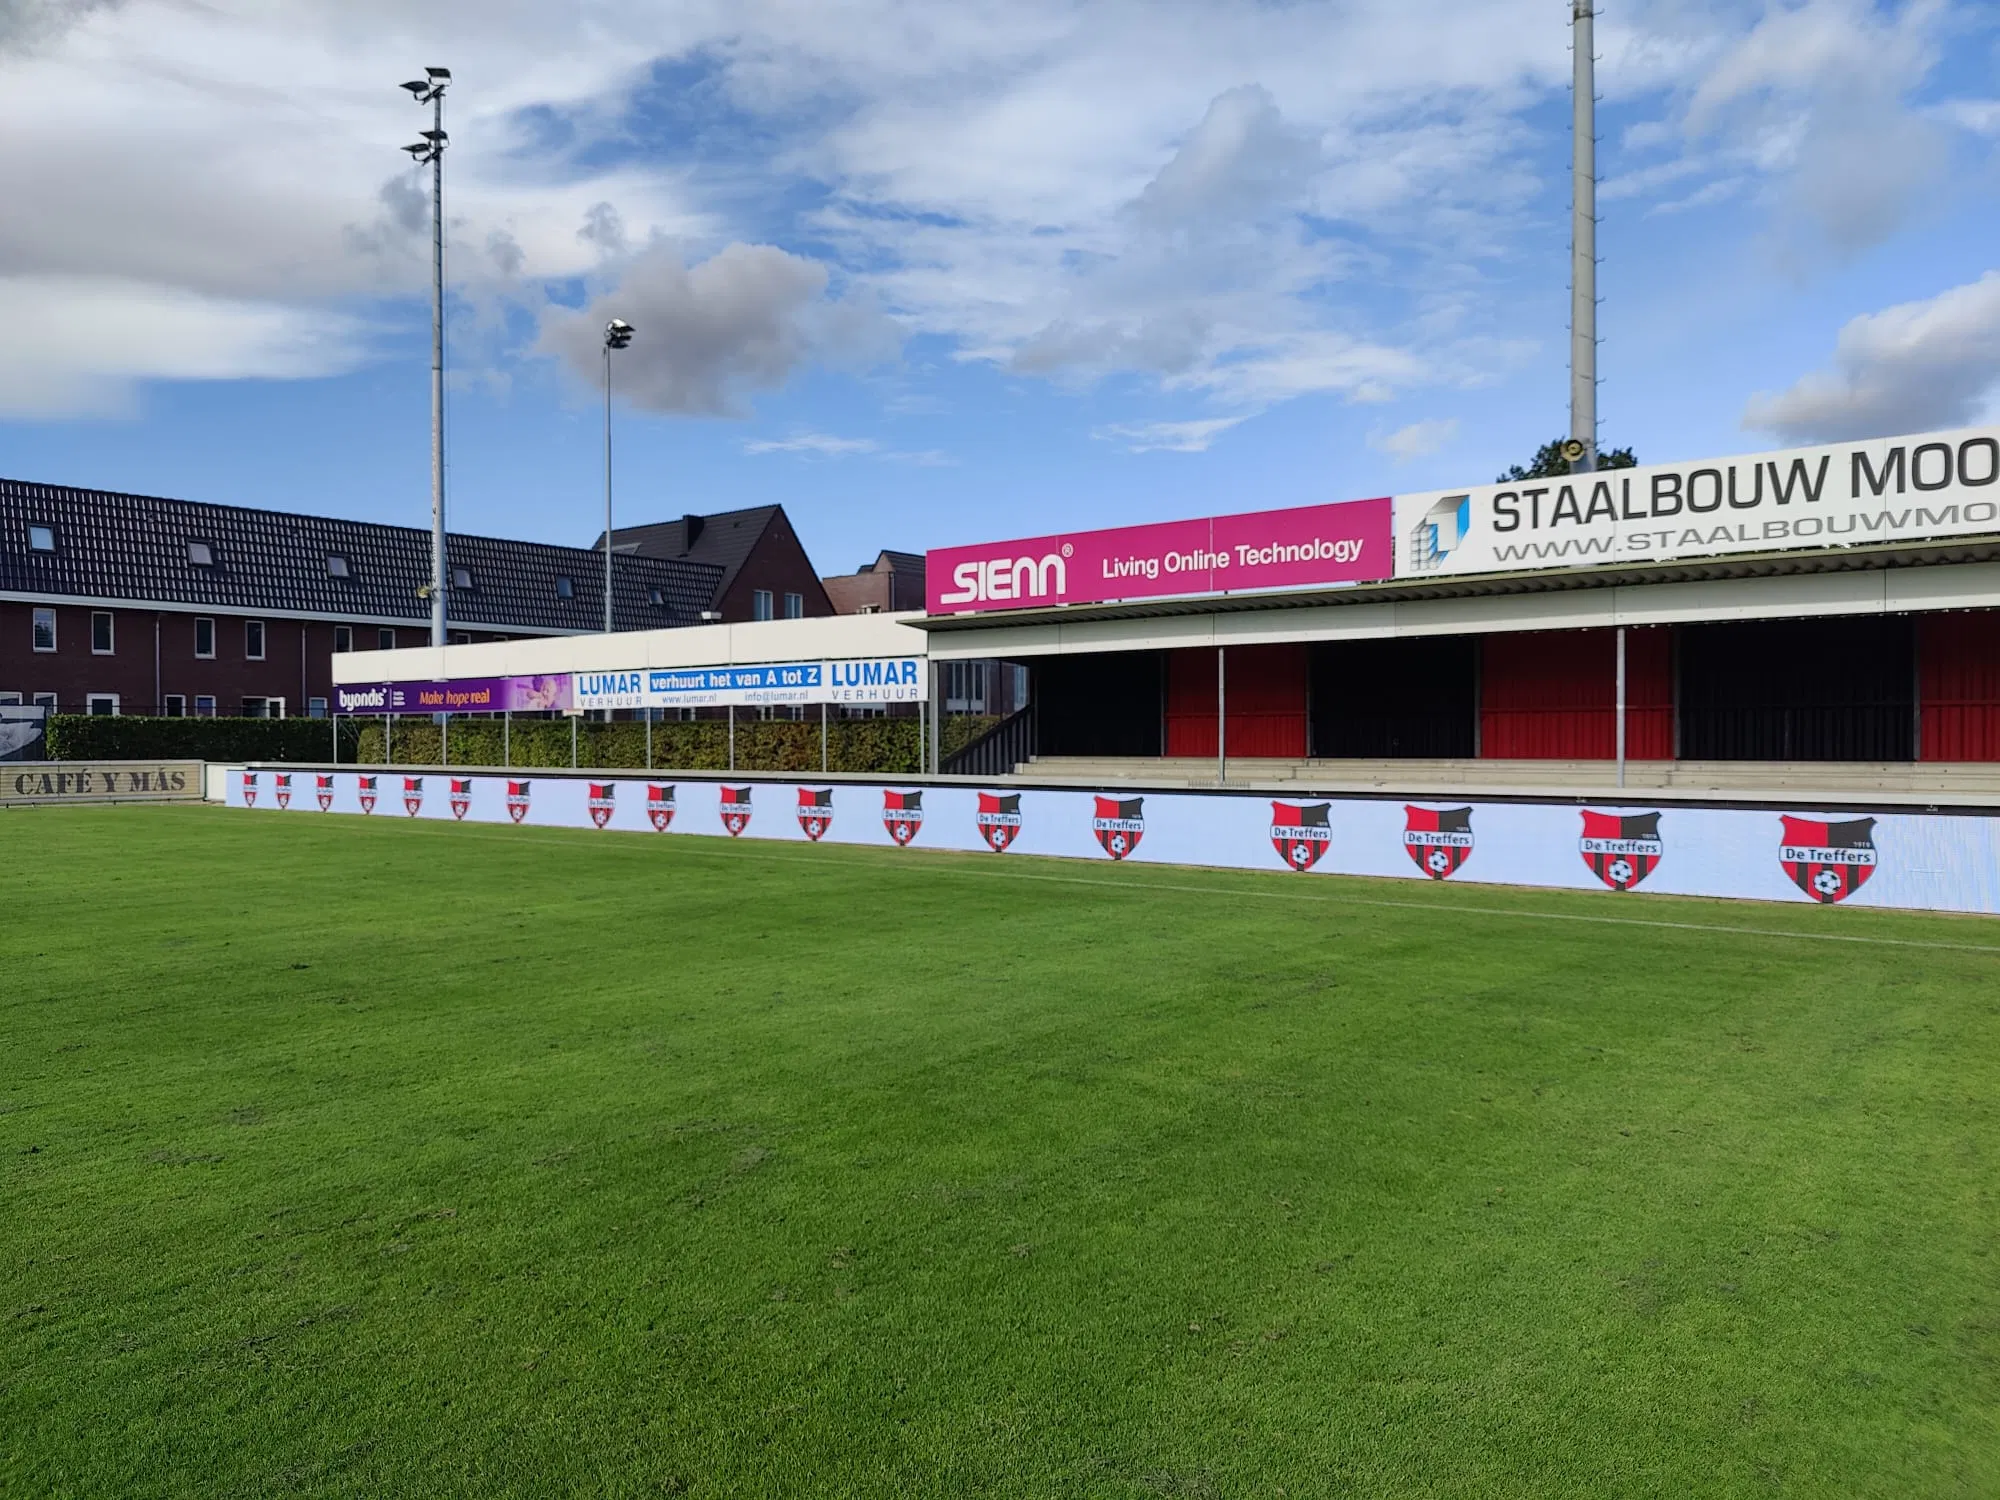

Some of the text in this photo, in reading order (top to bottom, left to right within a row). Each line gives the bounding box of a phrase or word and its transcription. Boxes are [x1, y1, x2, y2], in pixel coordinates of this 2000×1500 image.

[1492, 437, 2000, 533] STAALBOUW MOO
[1492, 502, 1998, 562] WWW.STAALBOUWMO
[1102, 537, 1363, 579] Living Online Technology
[651, 667, 819, 690] verhuurt het van A tot Z
[831, 660, 918, 687] LUMAR
[579, 673, 642, 696] LUMAR
[420, 690, 444, 705] Make
[446, 689, 470, 707] hope
[471, 688, 490, 703] real
[581, 695, 643, 708] VERHUUR
[662, 693, 717, 704] www.lumar.nl
[745, 689, 809, 703] info@lumar.nl
[832, 688, 919, 701] VERHUUR
[15, 768, 186, 795] CAFÉ Y MÁS
[1096, 819, 1141, 830] De Treffers
[1274, 827, 1328, 839] De Treffers
[1408, 833, 1469, 845] De Treffers
[1585, 840, 1657, 853] De Treffers
[1786, 848, 1871, 863] De Treffers
